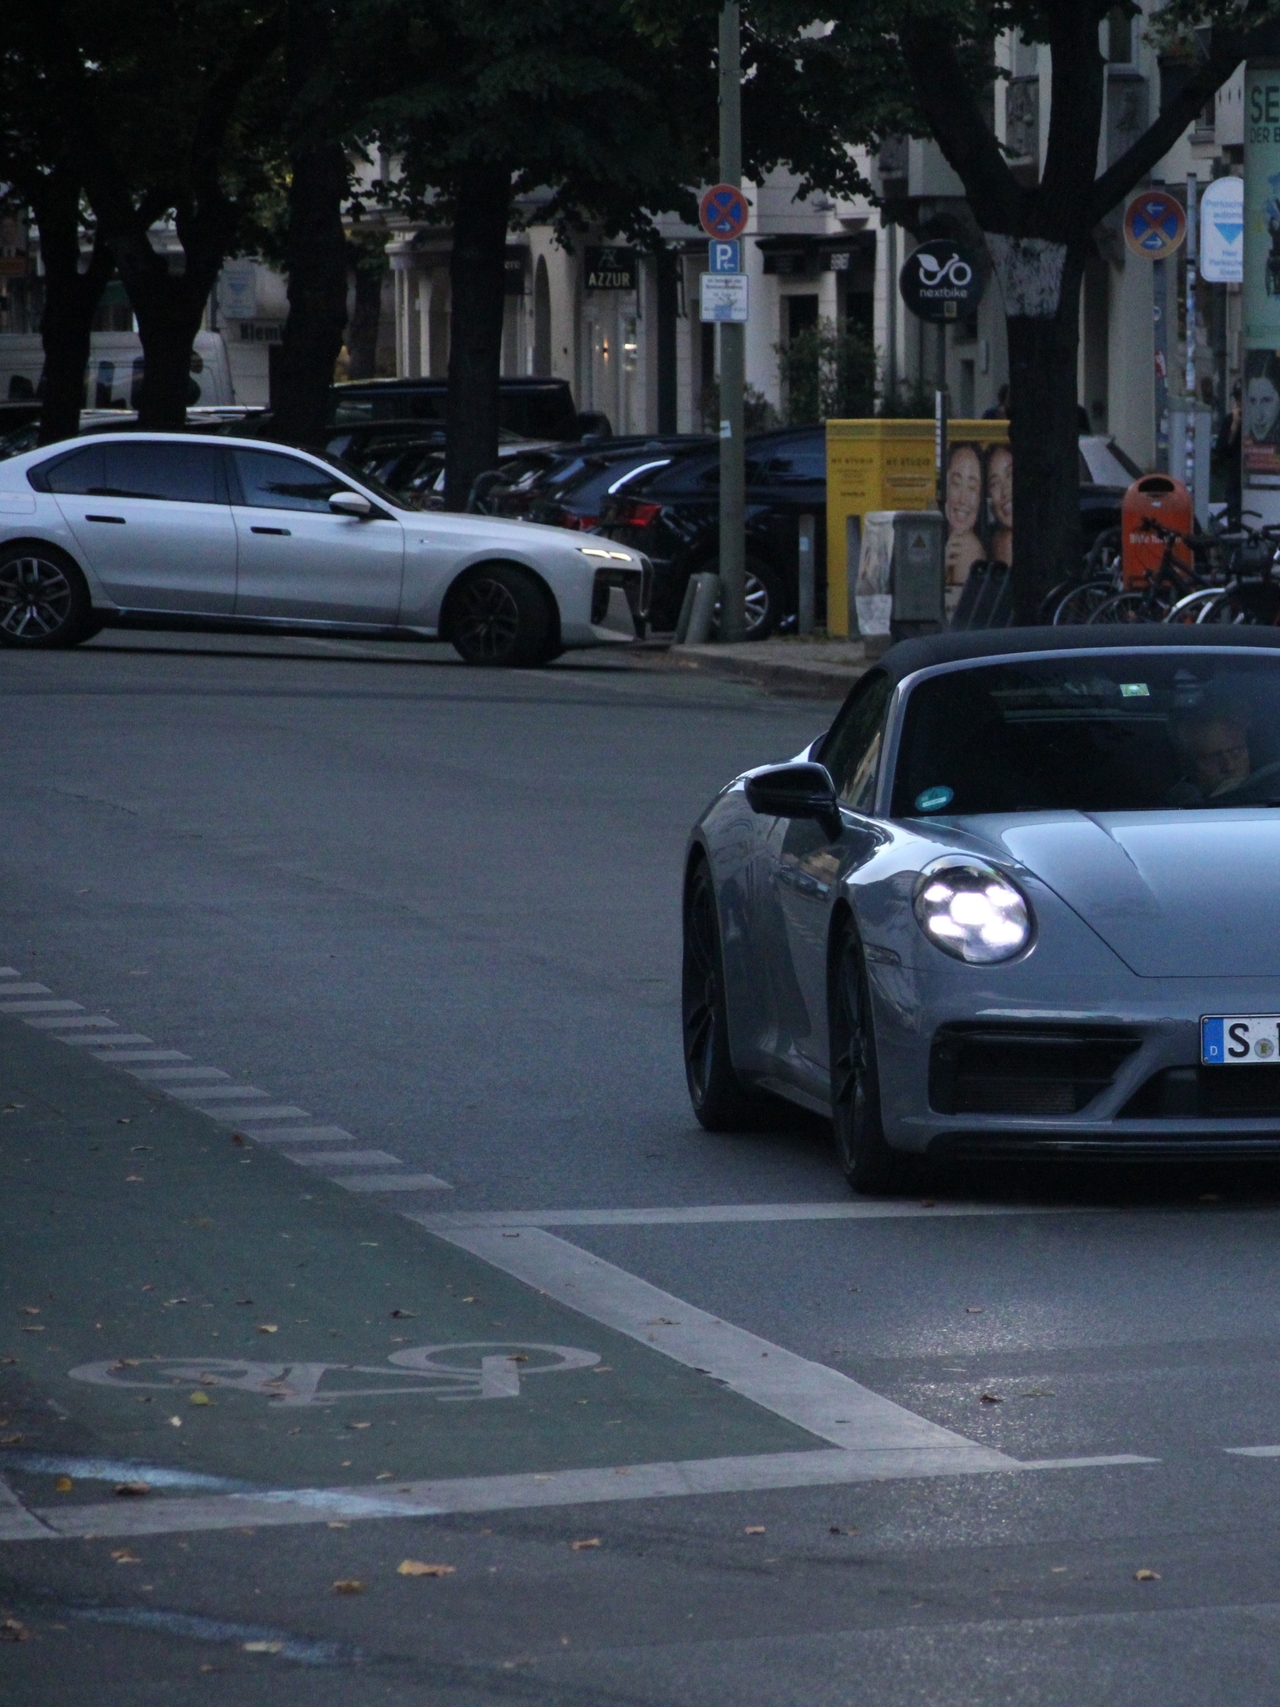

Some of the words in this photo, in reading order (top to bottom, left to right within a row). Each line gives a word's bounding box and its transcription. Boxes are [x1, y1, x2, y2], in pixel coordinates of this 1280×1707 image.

[1250, 126, 1270, 144] DER
[716, 244, 732, 270] P
[588, 272, 631, 287] AZZUR
[919, 287, 968, 299] nextbike
[1227, 1022, 1250, 1058] S
[1209, 1045, 1219, 1056] D
